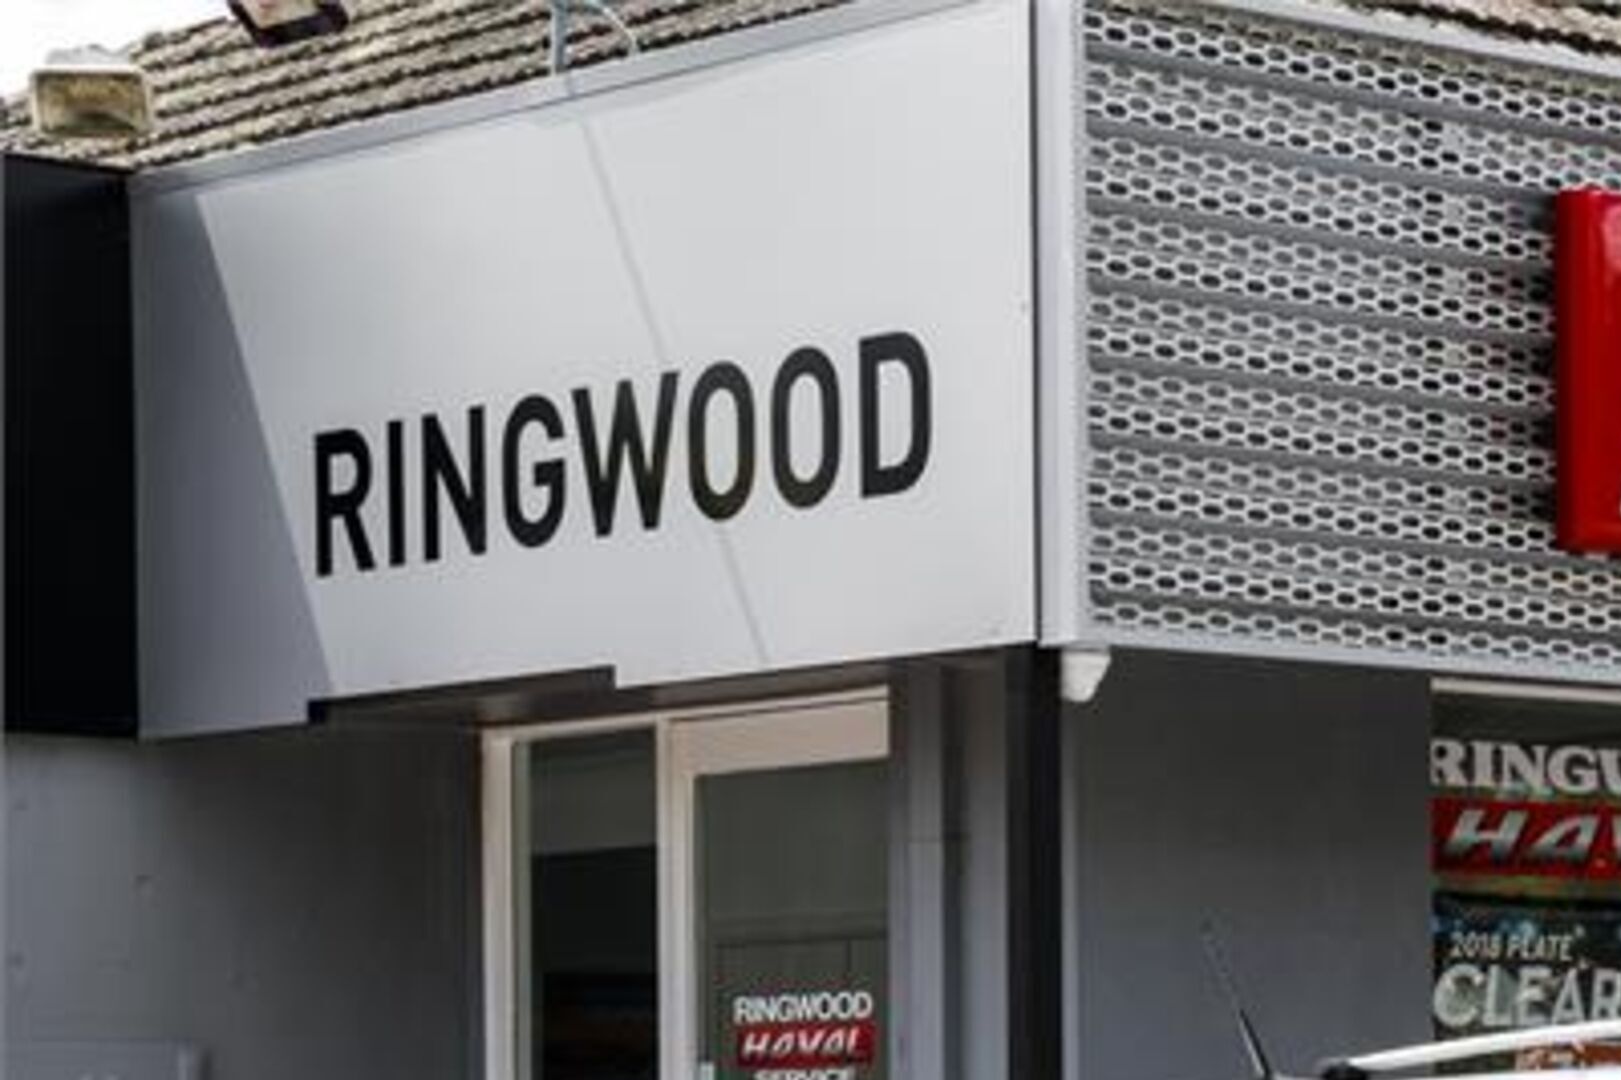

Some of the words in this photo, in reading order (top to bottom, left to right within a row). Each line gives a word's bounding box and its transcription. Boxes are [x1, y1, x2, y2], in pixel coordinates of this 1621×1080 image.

[314, 332, 931, 577] RINGWOOD
[733, 991, 872, 1023] RINGWOOD
[743, 1026, 866, 1058] HAVAL
